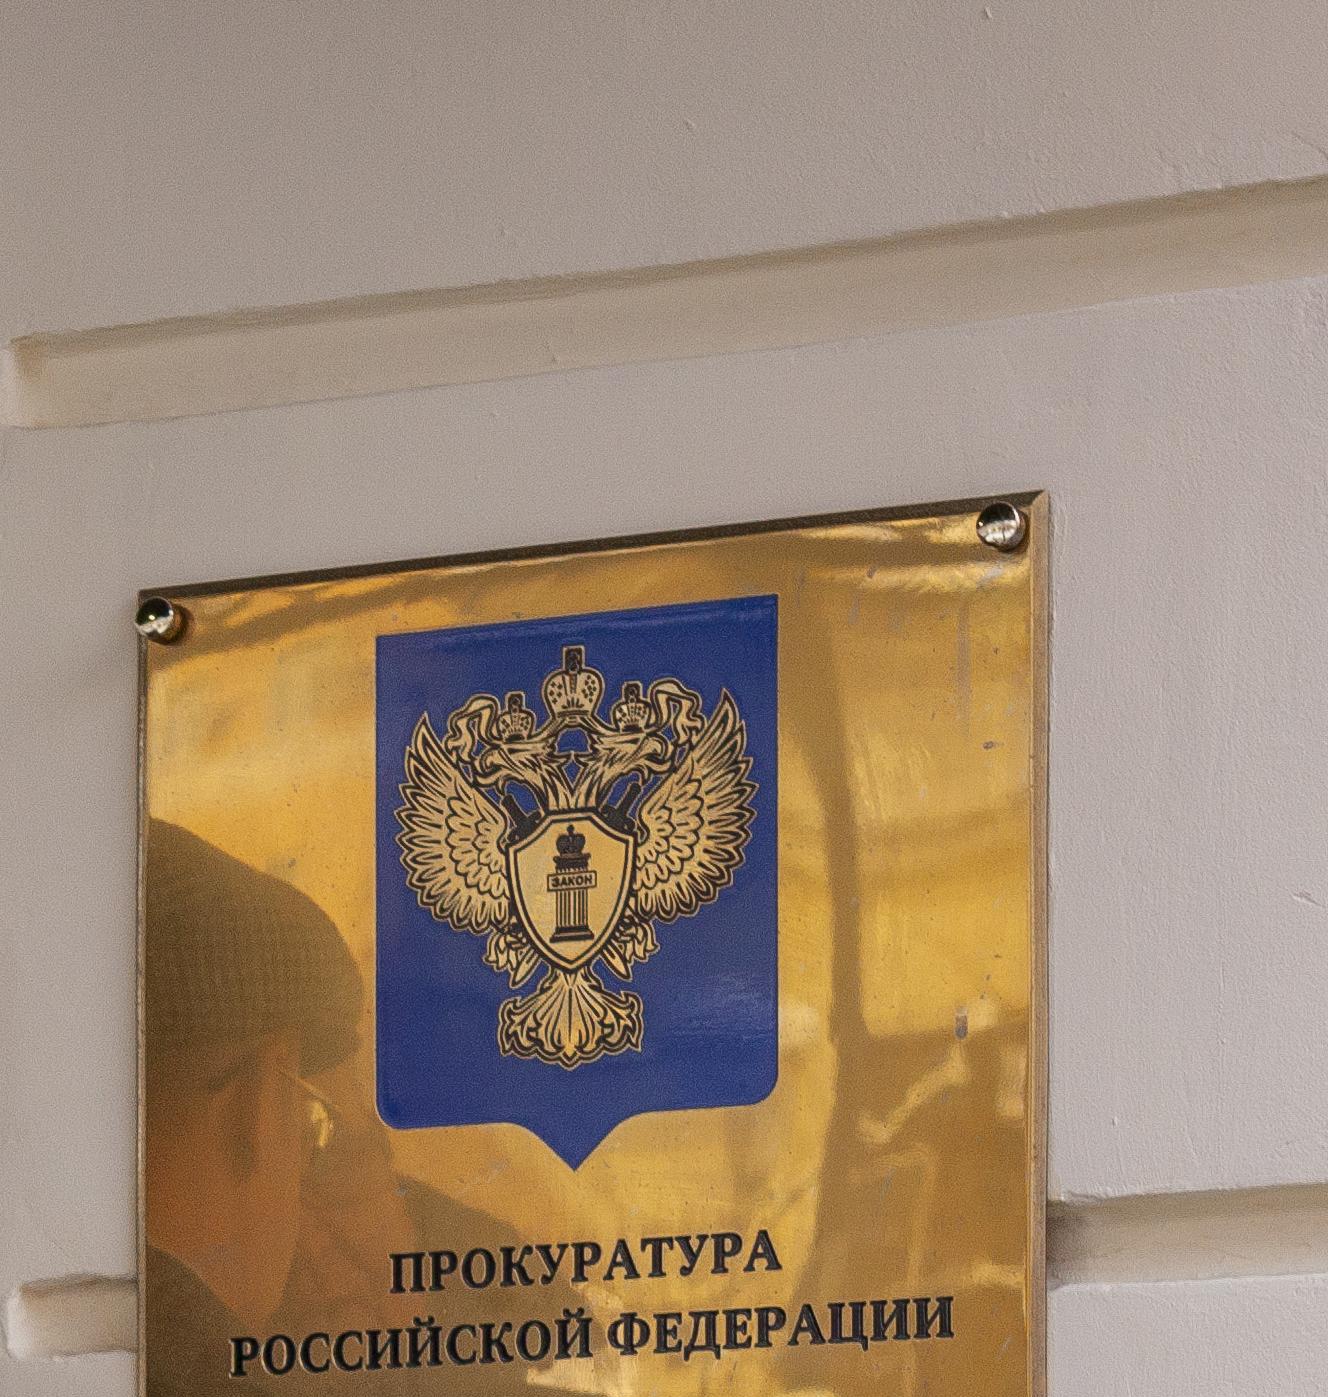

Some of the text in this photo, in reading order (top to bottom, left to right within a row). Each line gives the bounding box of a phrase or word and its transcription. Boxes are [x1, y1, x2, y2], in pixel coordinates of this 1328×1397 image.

[551, 874, 593, 888] ЗАКОН
[389, 1229, 782, 1294] ПРОКУРАТУРА
[229, 1296, 955, 1378] РОССИЙСКОЙ ФЕДЕРАЦИИ
